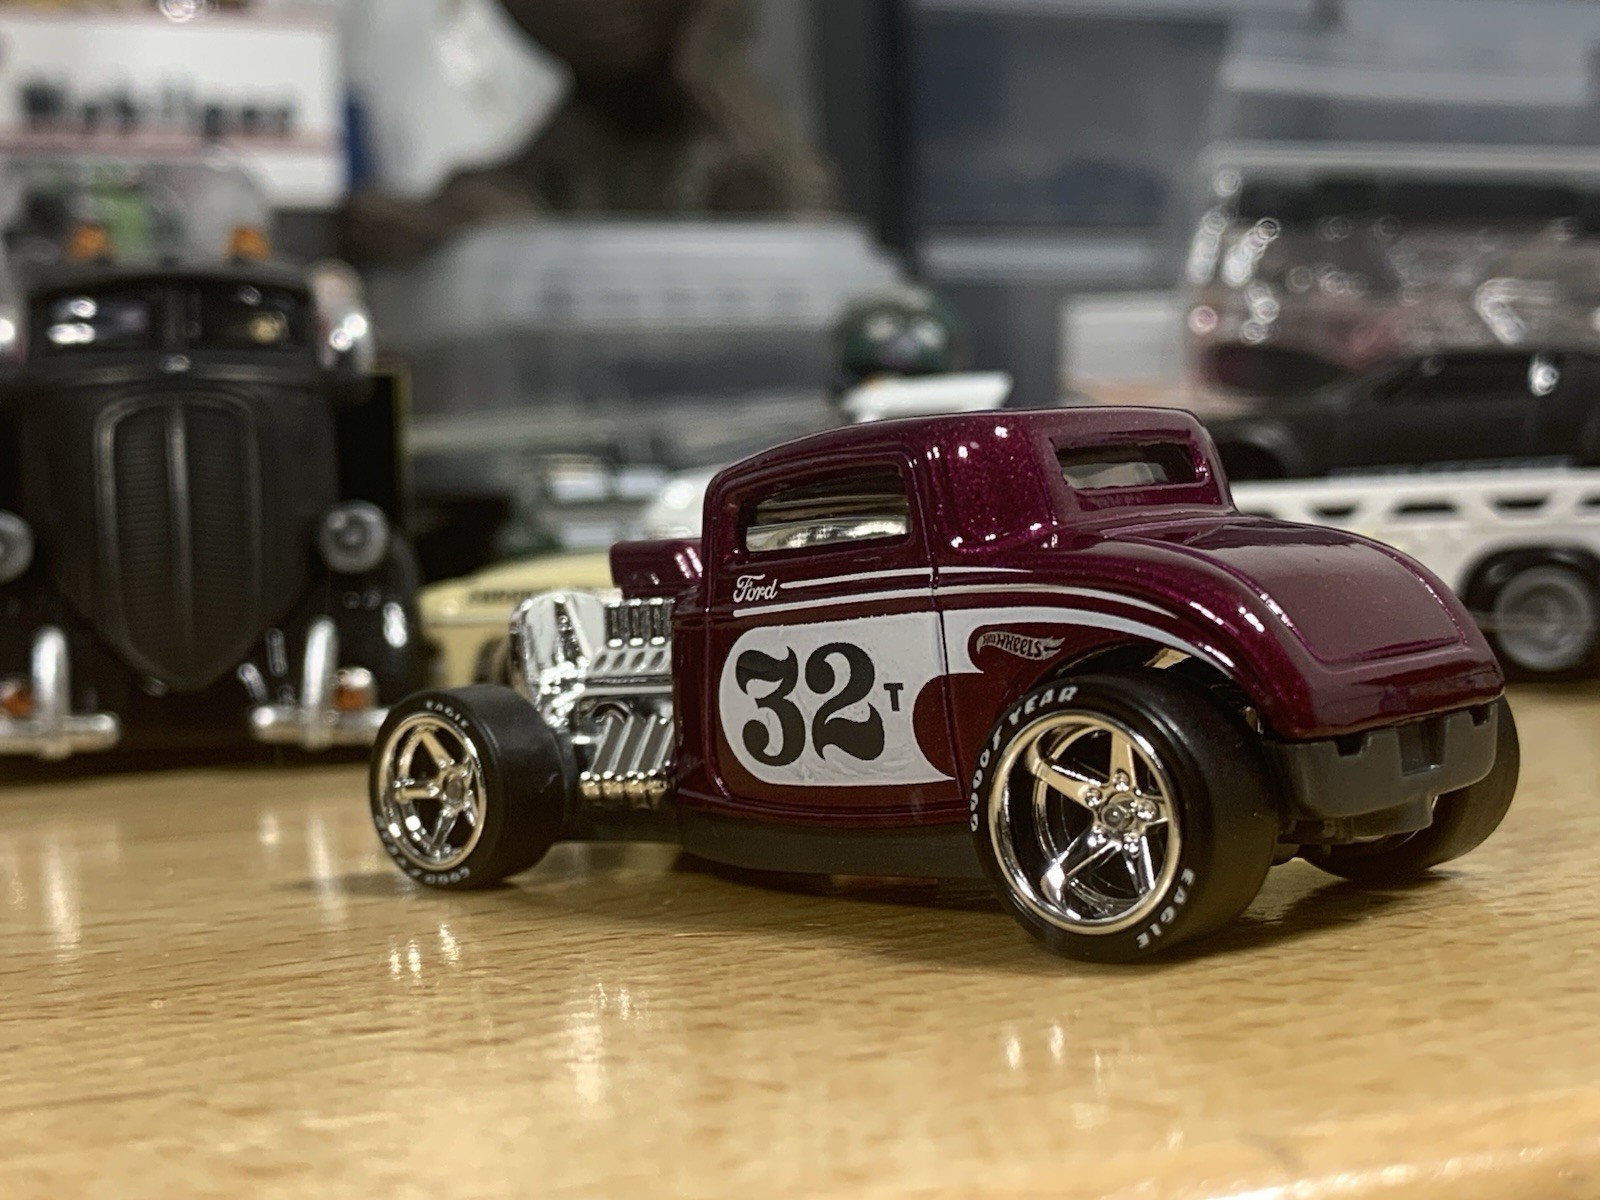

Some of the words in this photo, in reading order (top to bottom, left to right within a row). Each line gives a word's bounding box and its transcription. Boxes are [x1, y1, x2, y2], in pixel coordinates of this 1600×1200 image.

[732, 573, 779, 604] Ford
[734, 641, 886, 768] 32
[883, 682, 904, 712] T
[1135, 867, 1195, 949] EAGLE
